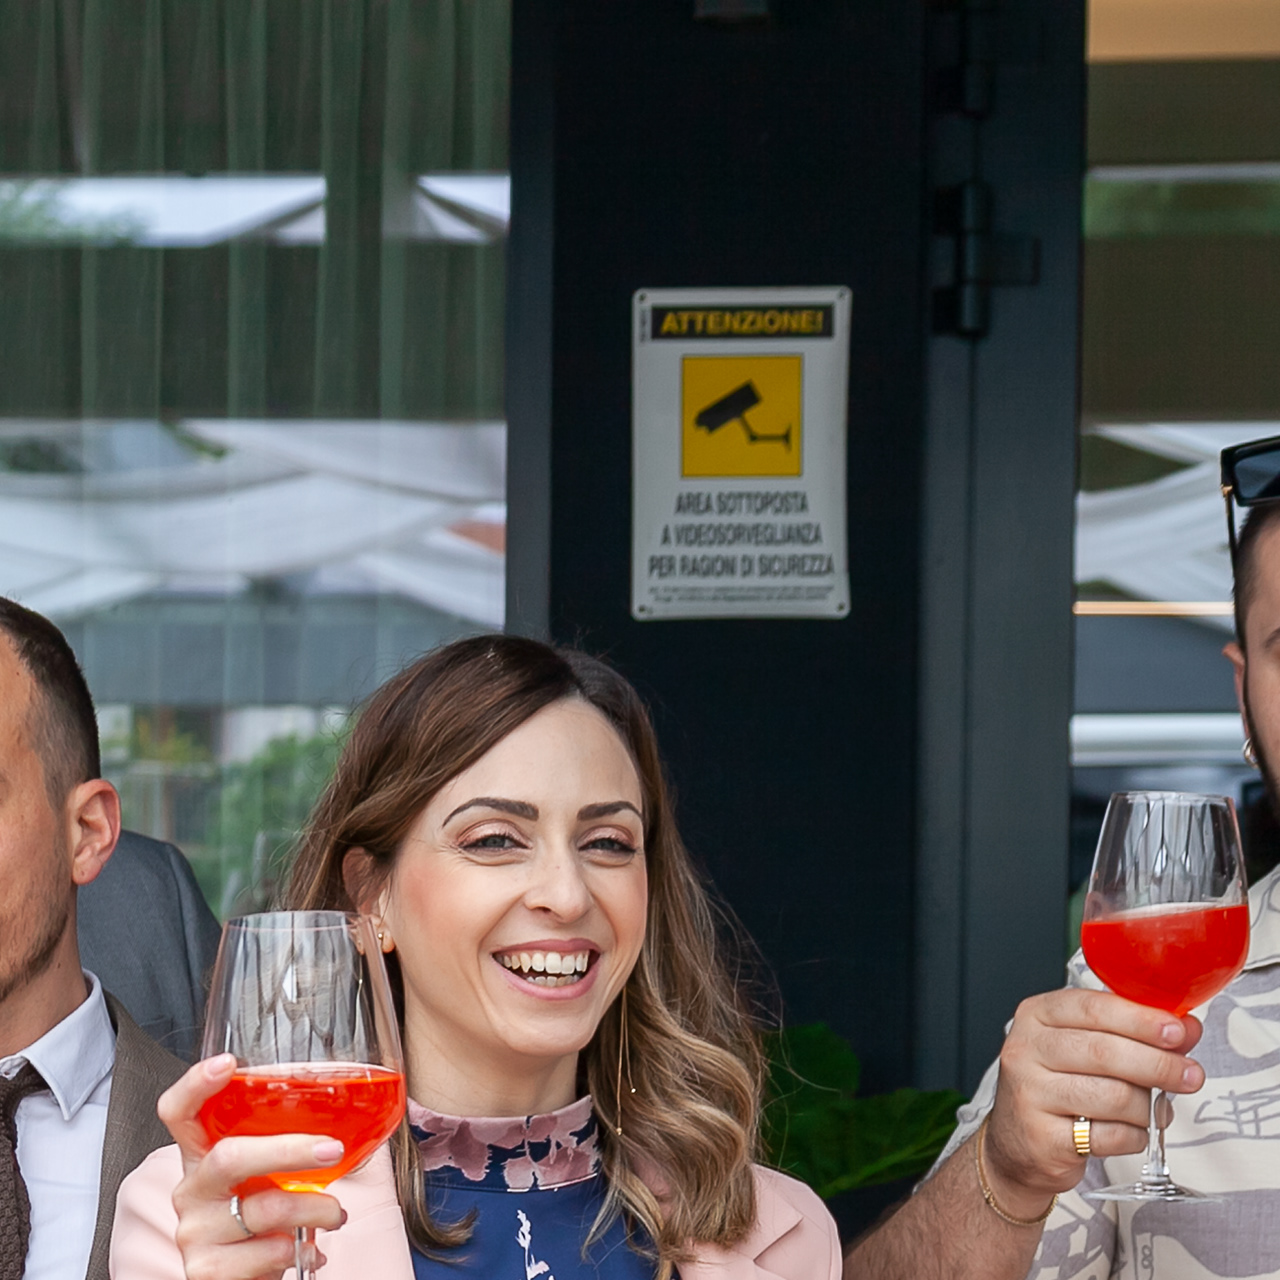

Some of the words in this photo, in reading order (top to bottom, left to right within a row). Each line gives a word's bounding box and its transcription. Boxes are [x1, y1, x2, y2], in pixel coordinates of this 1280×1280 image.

[660, 309, 824, 335] ATTENZIONE!
[675, 492, 714, 515] AREA
[716, 491, 810, 515] SOTTOPOSTA
[661, 524, 672, 546] A
[674, 523, 823, 546] VIDEOSORVEGLIANZA
[648, 554, 677, 579] PER
[679, 554, 737, 577] RAGIONI
[740, 554, 754, 577] DI
[758, 553, 835, 577] SICUREZZA
